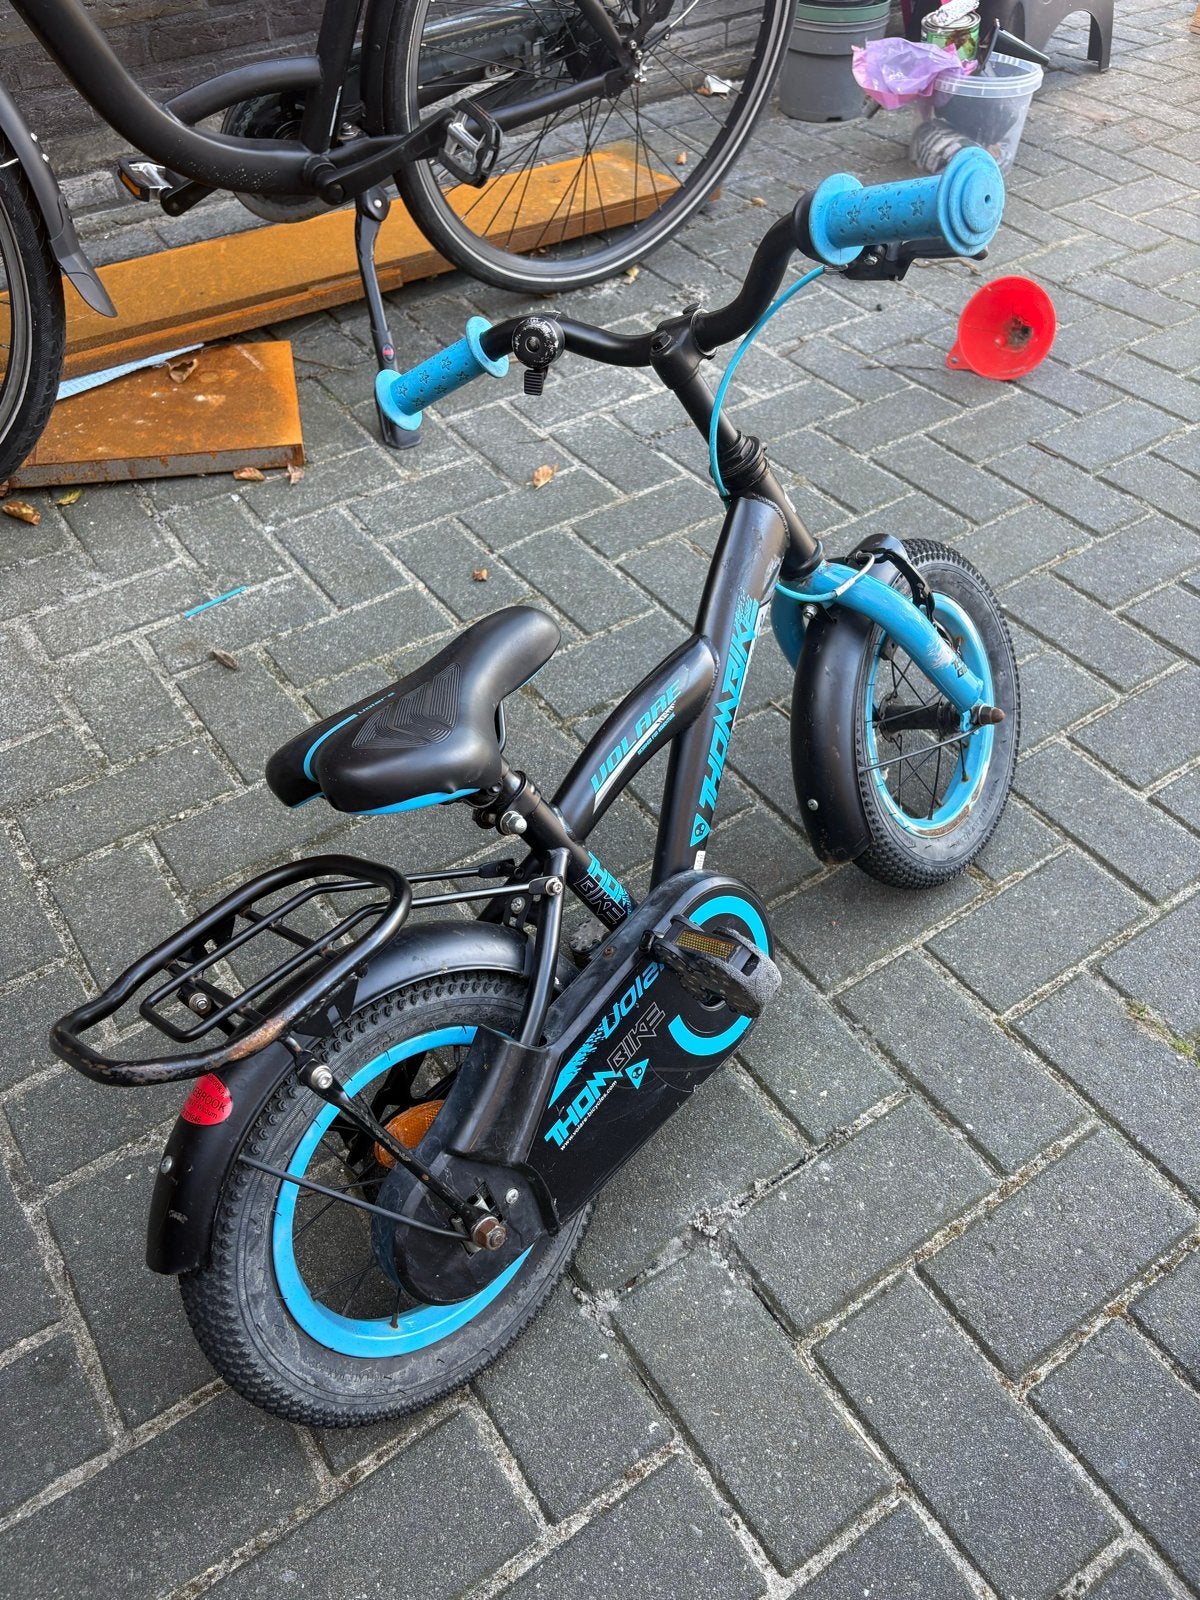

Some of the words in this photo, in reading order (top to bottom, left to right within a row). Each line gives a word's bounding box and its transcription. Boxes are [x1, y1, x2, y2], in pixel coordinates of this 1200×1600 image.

[576, 875, 626, 926] BIKE
[543, 1070, 624, 1147] THOM
[607, 1001, 666, 1075] BIKE
[560, 1080, 618, 1151] www.volare-bicycles.com
